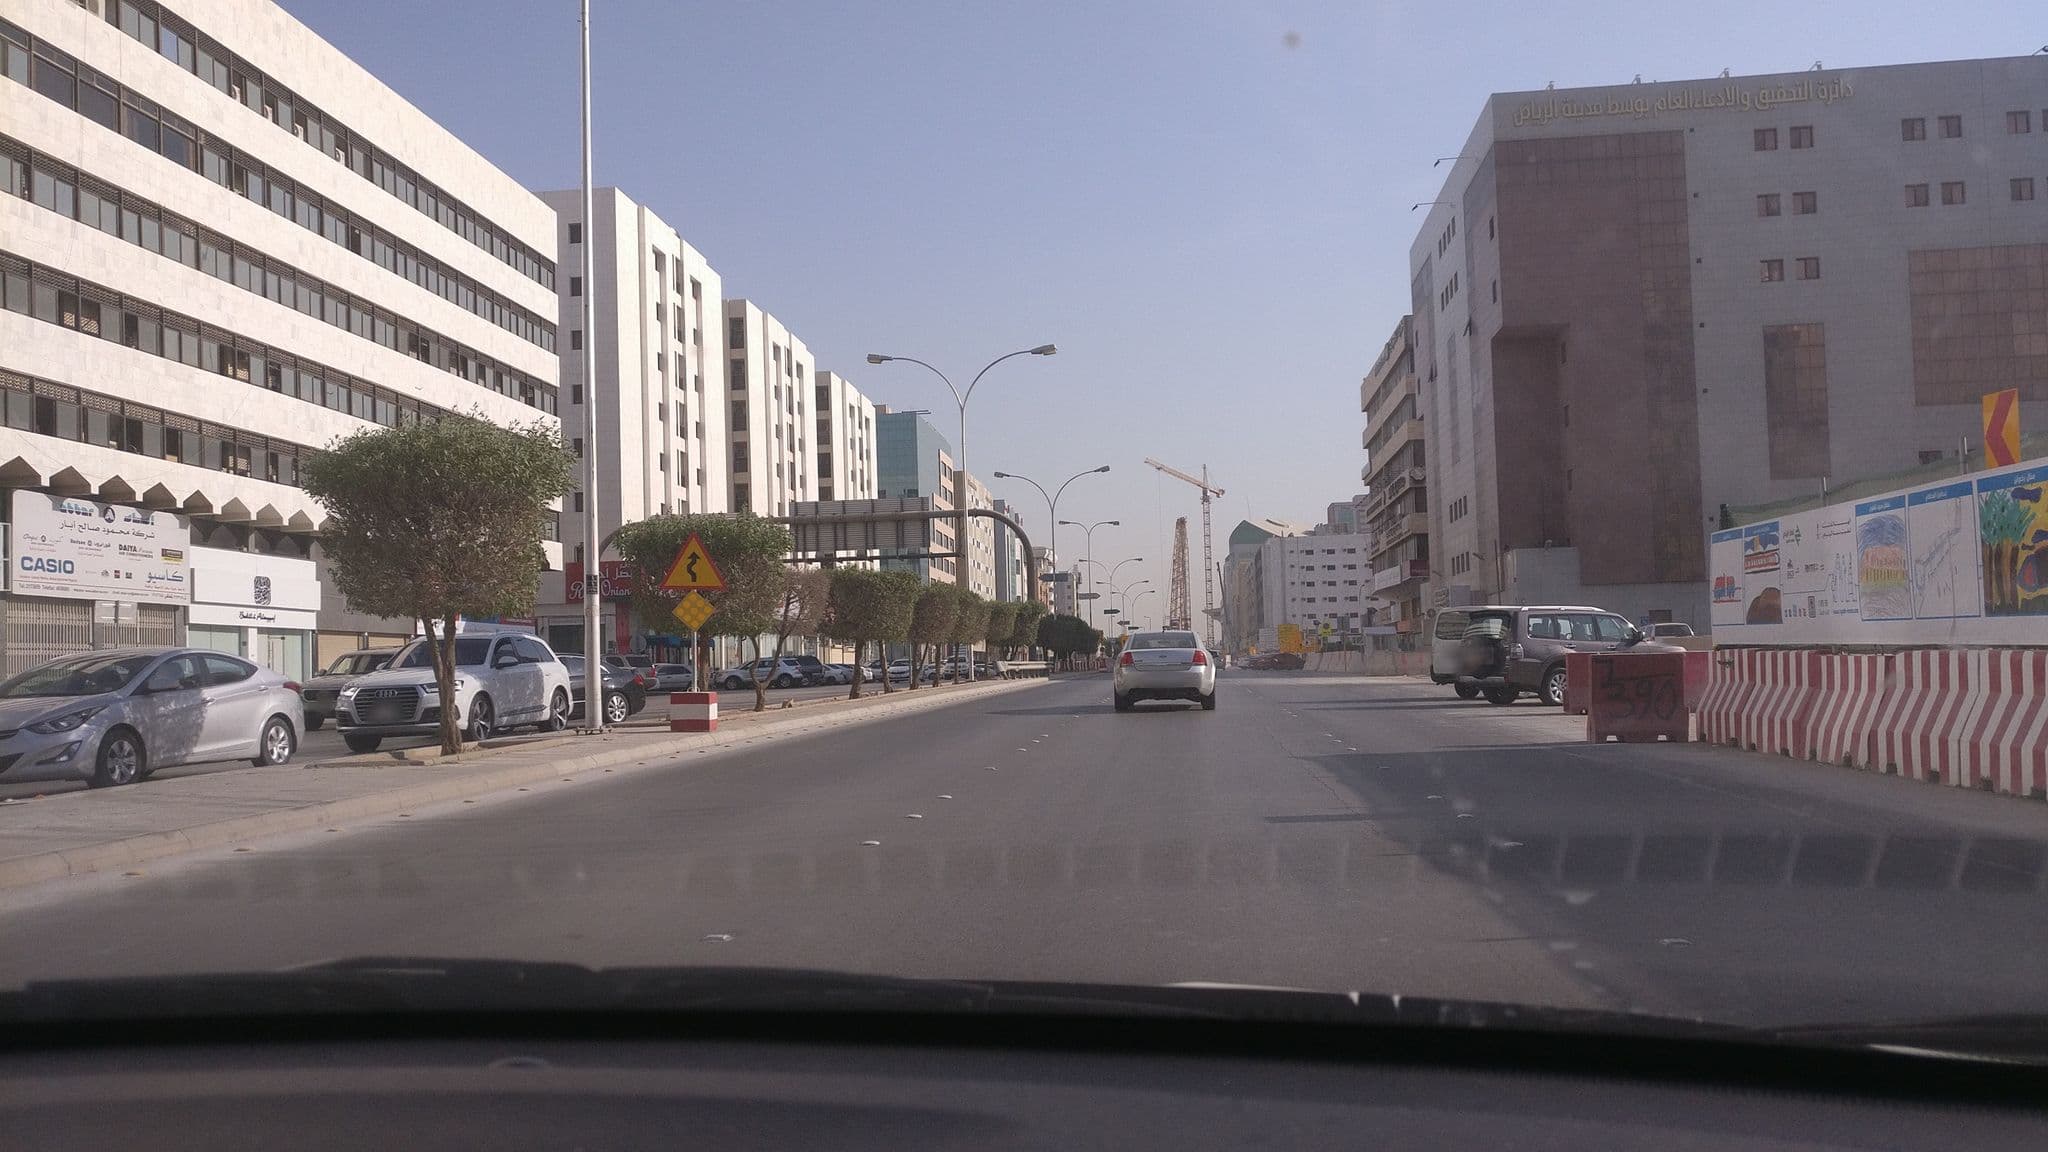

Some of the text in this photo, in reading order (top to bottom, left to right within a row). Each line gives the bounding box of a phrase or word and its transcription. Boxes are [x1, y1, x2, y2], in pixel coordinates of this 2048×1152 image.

[1755, 79, 1813, 111] التحقيق
[1816, 78, 1853, 105] دائرة
[1563, 97, 1603, 121] مدينة
[1607, 95, 1648, 119] بوسط
[1654, 88, 1692, 116] العام
[1513, 100, 1559, 127] الرياض
[78, 522, 100, 533] صالح
[102, 526, 130, 536] محمود
[132, 528, 155, 540] شركة
[118, 544, 138, 553] DAIYA
[21, 556, 75, 574] CASIO
[146, 568, 184, 584] كاسيو
[600, 579, 631, 597] Onion
